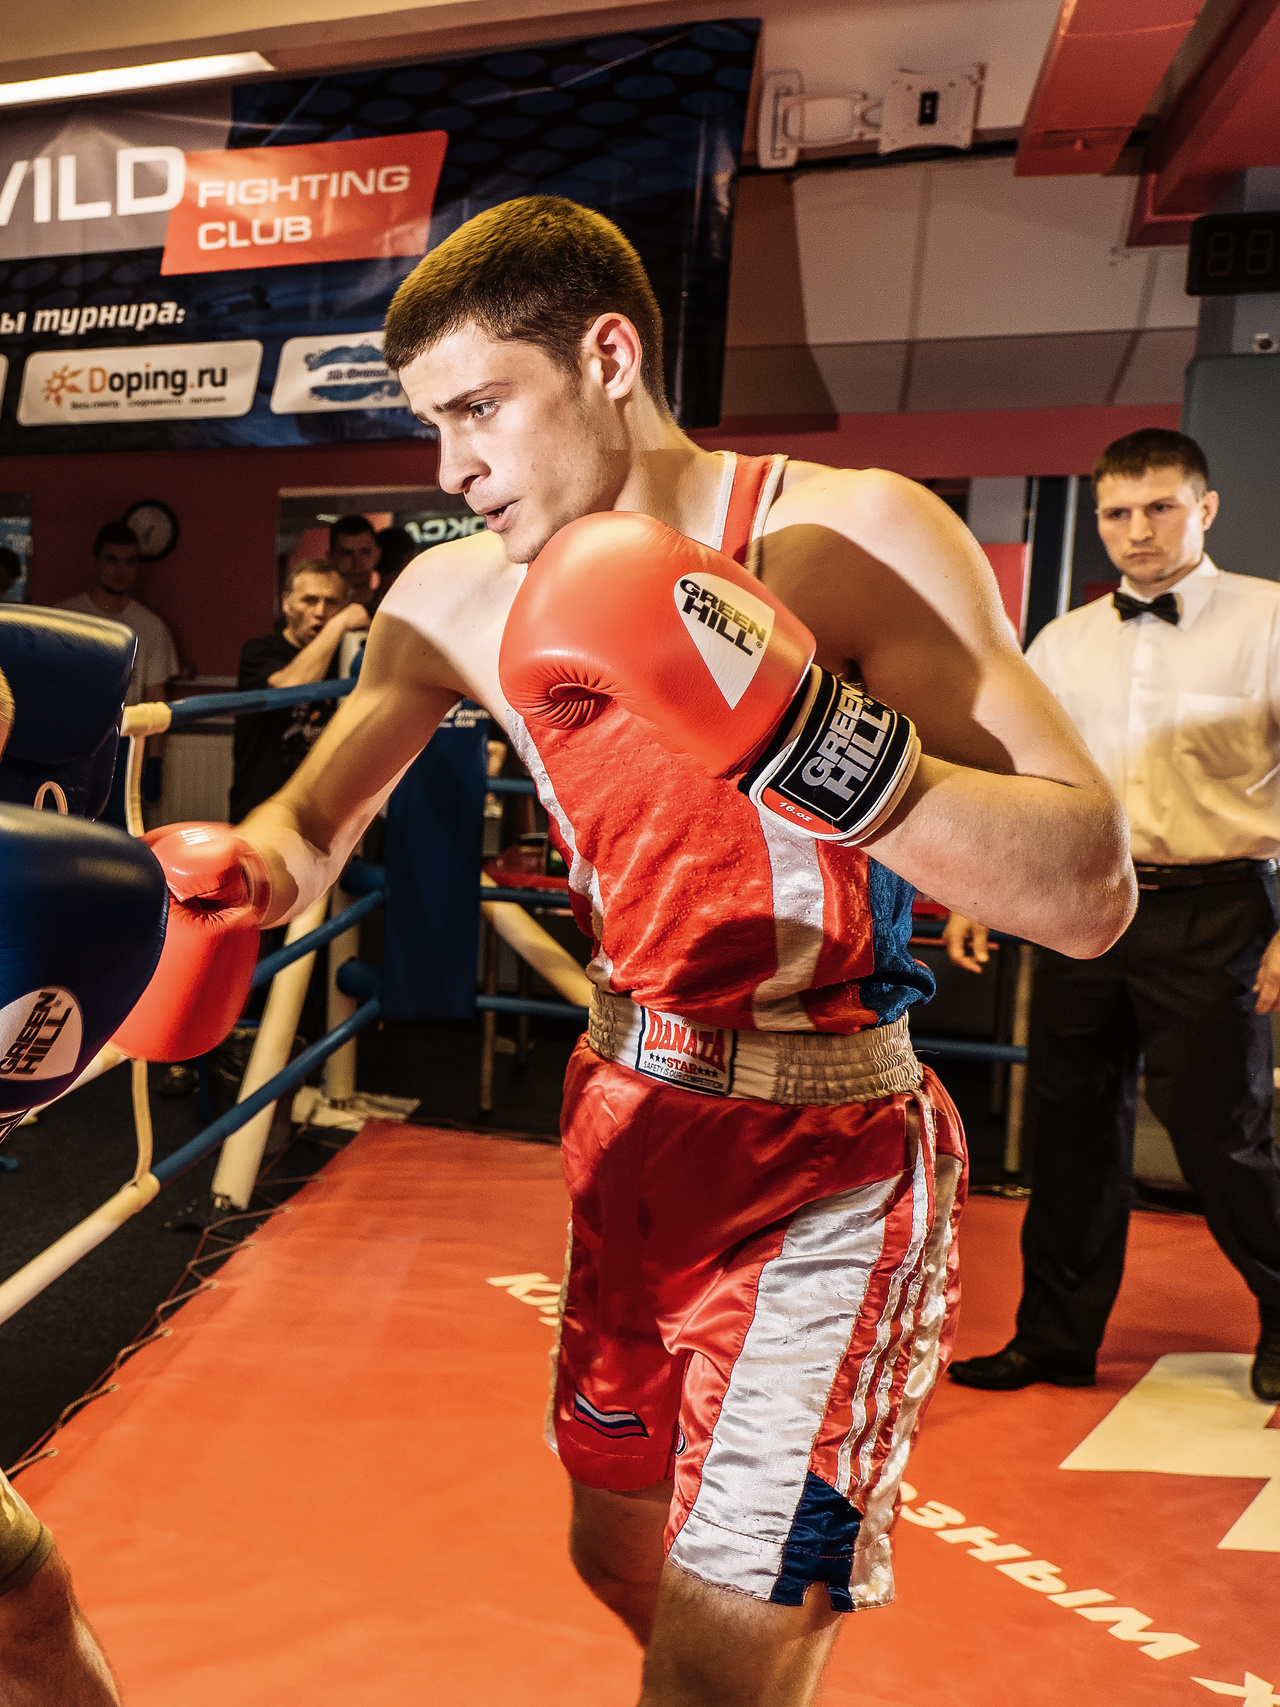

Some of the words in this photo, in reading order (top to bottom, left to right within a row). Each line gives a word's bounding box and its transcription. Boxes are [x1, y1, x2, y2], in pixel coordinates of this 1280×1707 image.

[197, 165, 410, 208] FIGHTING
[197, 216, 313, 251] CLUB
[32, 301, 186, 335] турнира:
[88, 363, 228, 396] Doping.ru
[680, 579, 766, 642] GREEN
[682, 595, 753, 656] HILL
[801, 681, 863, 787] GREEN
[823, 709, 892, 800] HILL
[12, 1007, 73, 1075] HILL
[643, 1061, 663, 1074] SAFETY
[666, 1057, 697, 1075] STAR
